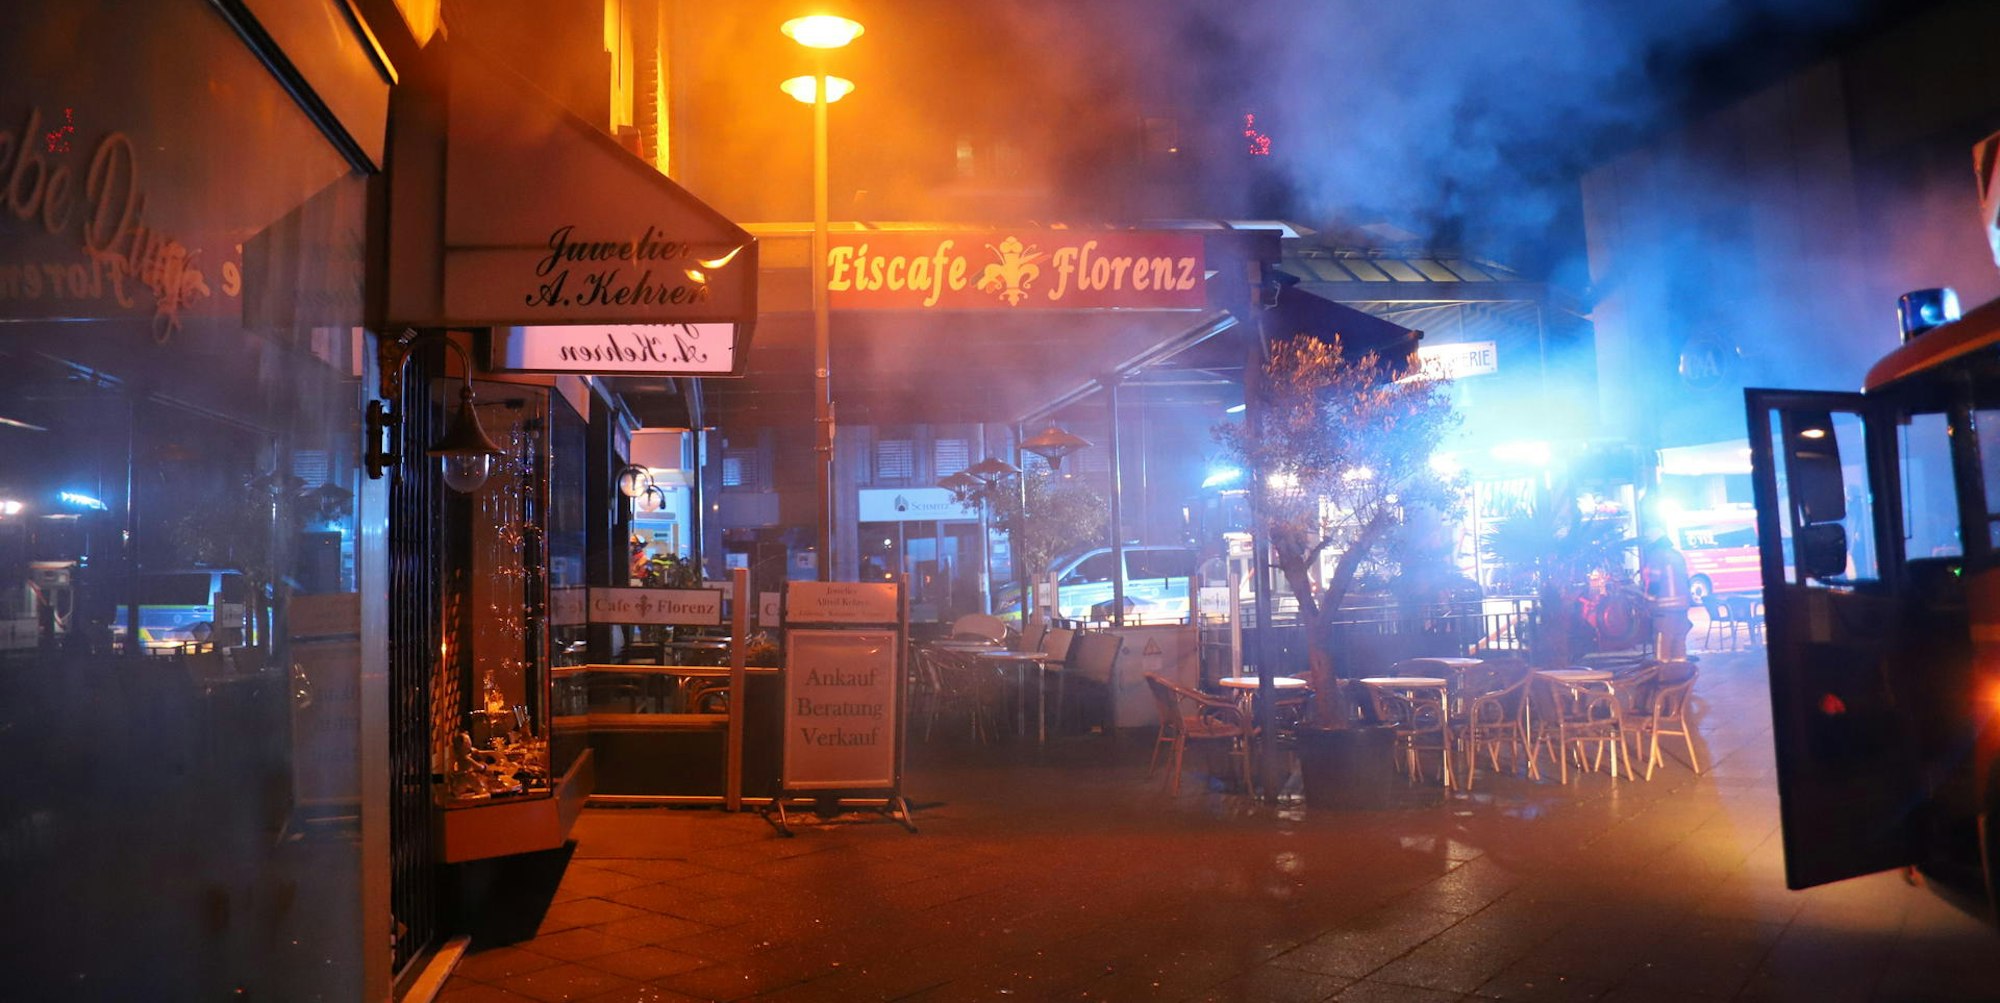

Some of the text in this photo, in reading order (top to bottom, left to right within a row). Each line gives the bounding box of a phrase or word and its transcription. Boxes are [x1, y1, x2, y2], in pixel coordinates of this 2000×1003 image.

[535, 225, 690, 276] Juwelier
[827, 239, 1196, 308] Eiscafe Florenz
[594, 598, 631, 613] Cafe
[657, 599, 715, 615] Florenz
[805, 668, 879, 687] Ankauf
[796, 697, 883, 718] Beratung
[800, 727, 881, 747] Verkauf
